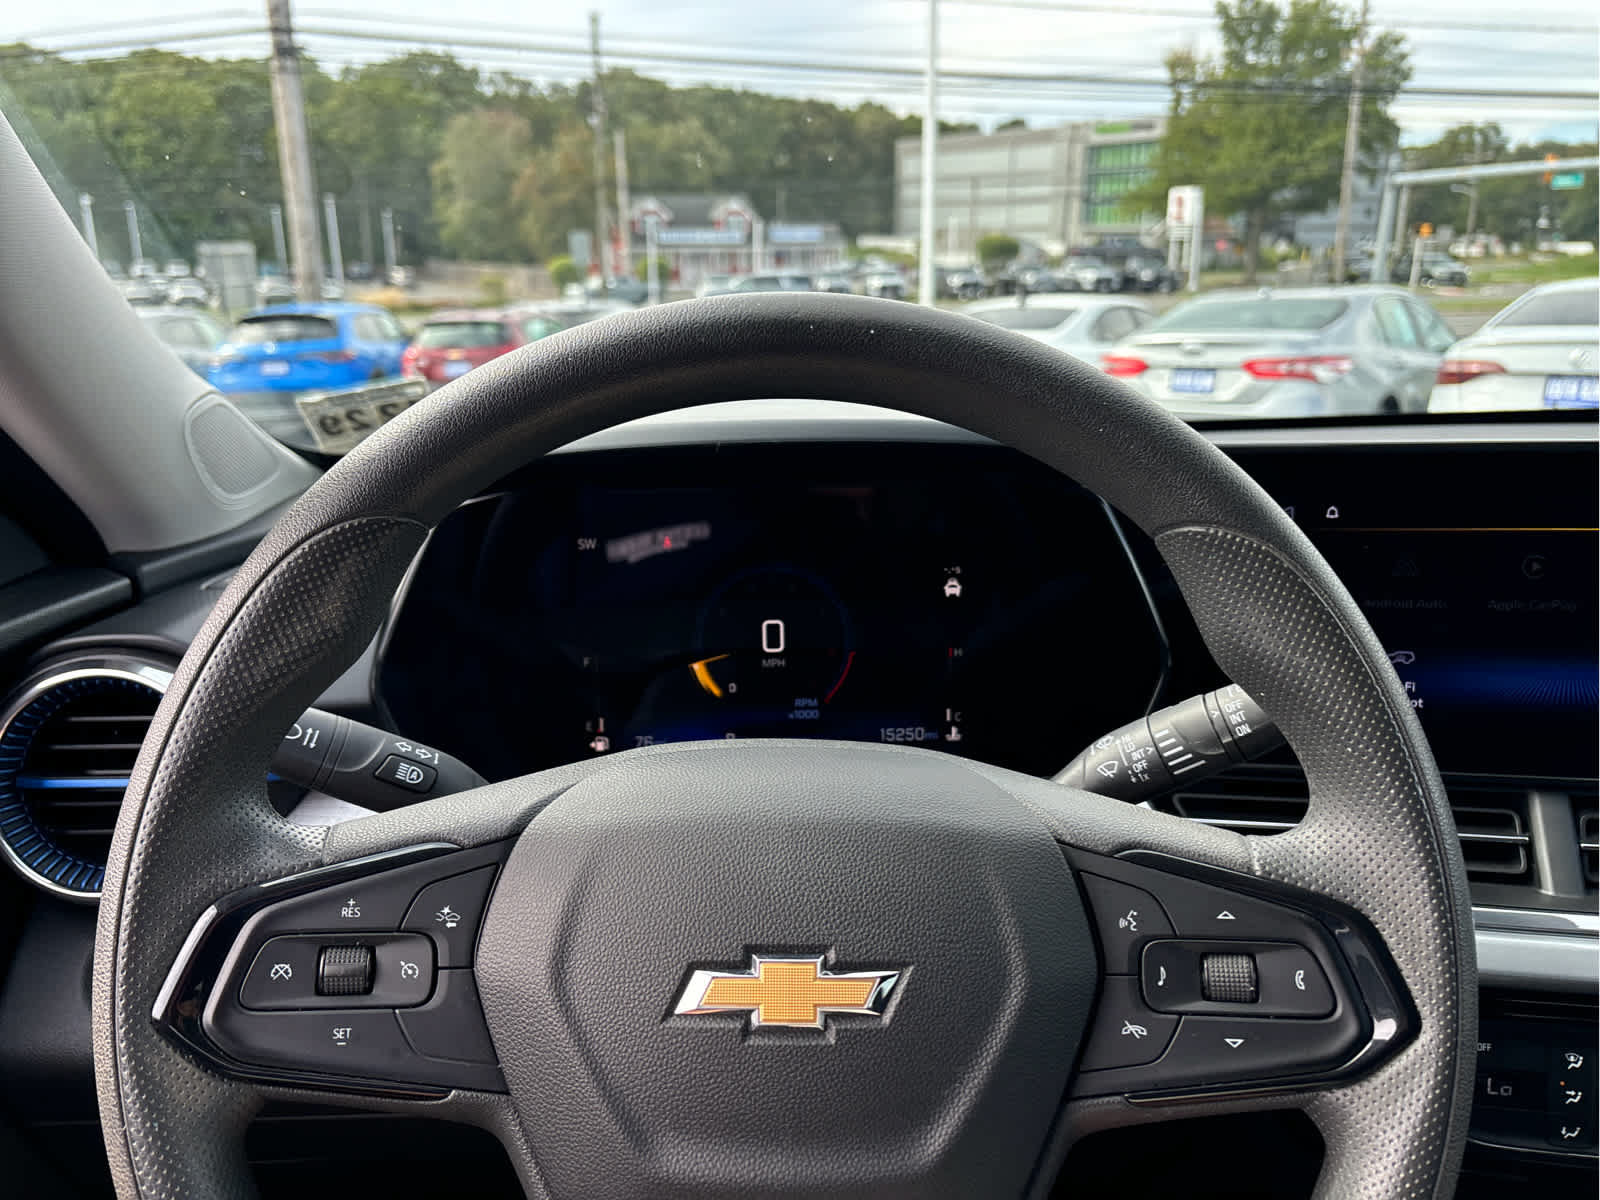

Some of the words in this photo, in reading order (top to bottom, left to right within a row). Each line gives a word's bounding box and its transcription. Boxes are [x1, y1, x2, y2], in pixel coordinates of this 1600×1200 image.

[577, 537, 597, 551] SW
[762, 619, 784, 653] 0
[762, 657, 786, 669] MPH
[794, 697, 819, 708] RPM
[1224, 699, 1242, 713] OFF
[1229, 710, 1246, 725] INT
[880, 727, 924, 742] 15250
[1235, 723, 1252, 737] ON
[1131, 748, 1145, 761] INT
[1132, 760, 1148, 773] OFF
[341, 906, 361, 918] RES
[332, 1027, 352, 1039] SET
[1478, 1042, 1494, 1052] OFF
